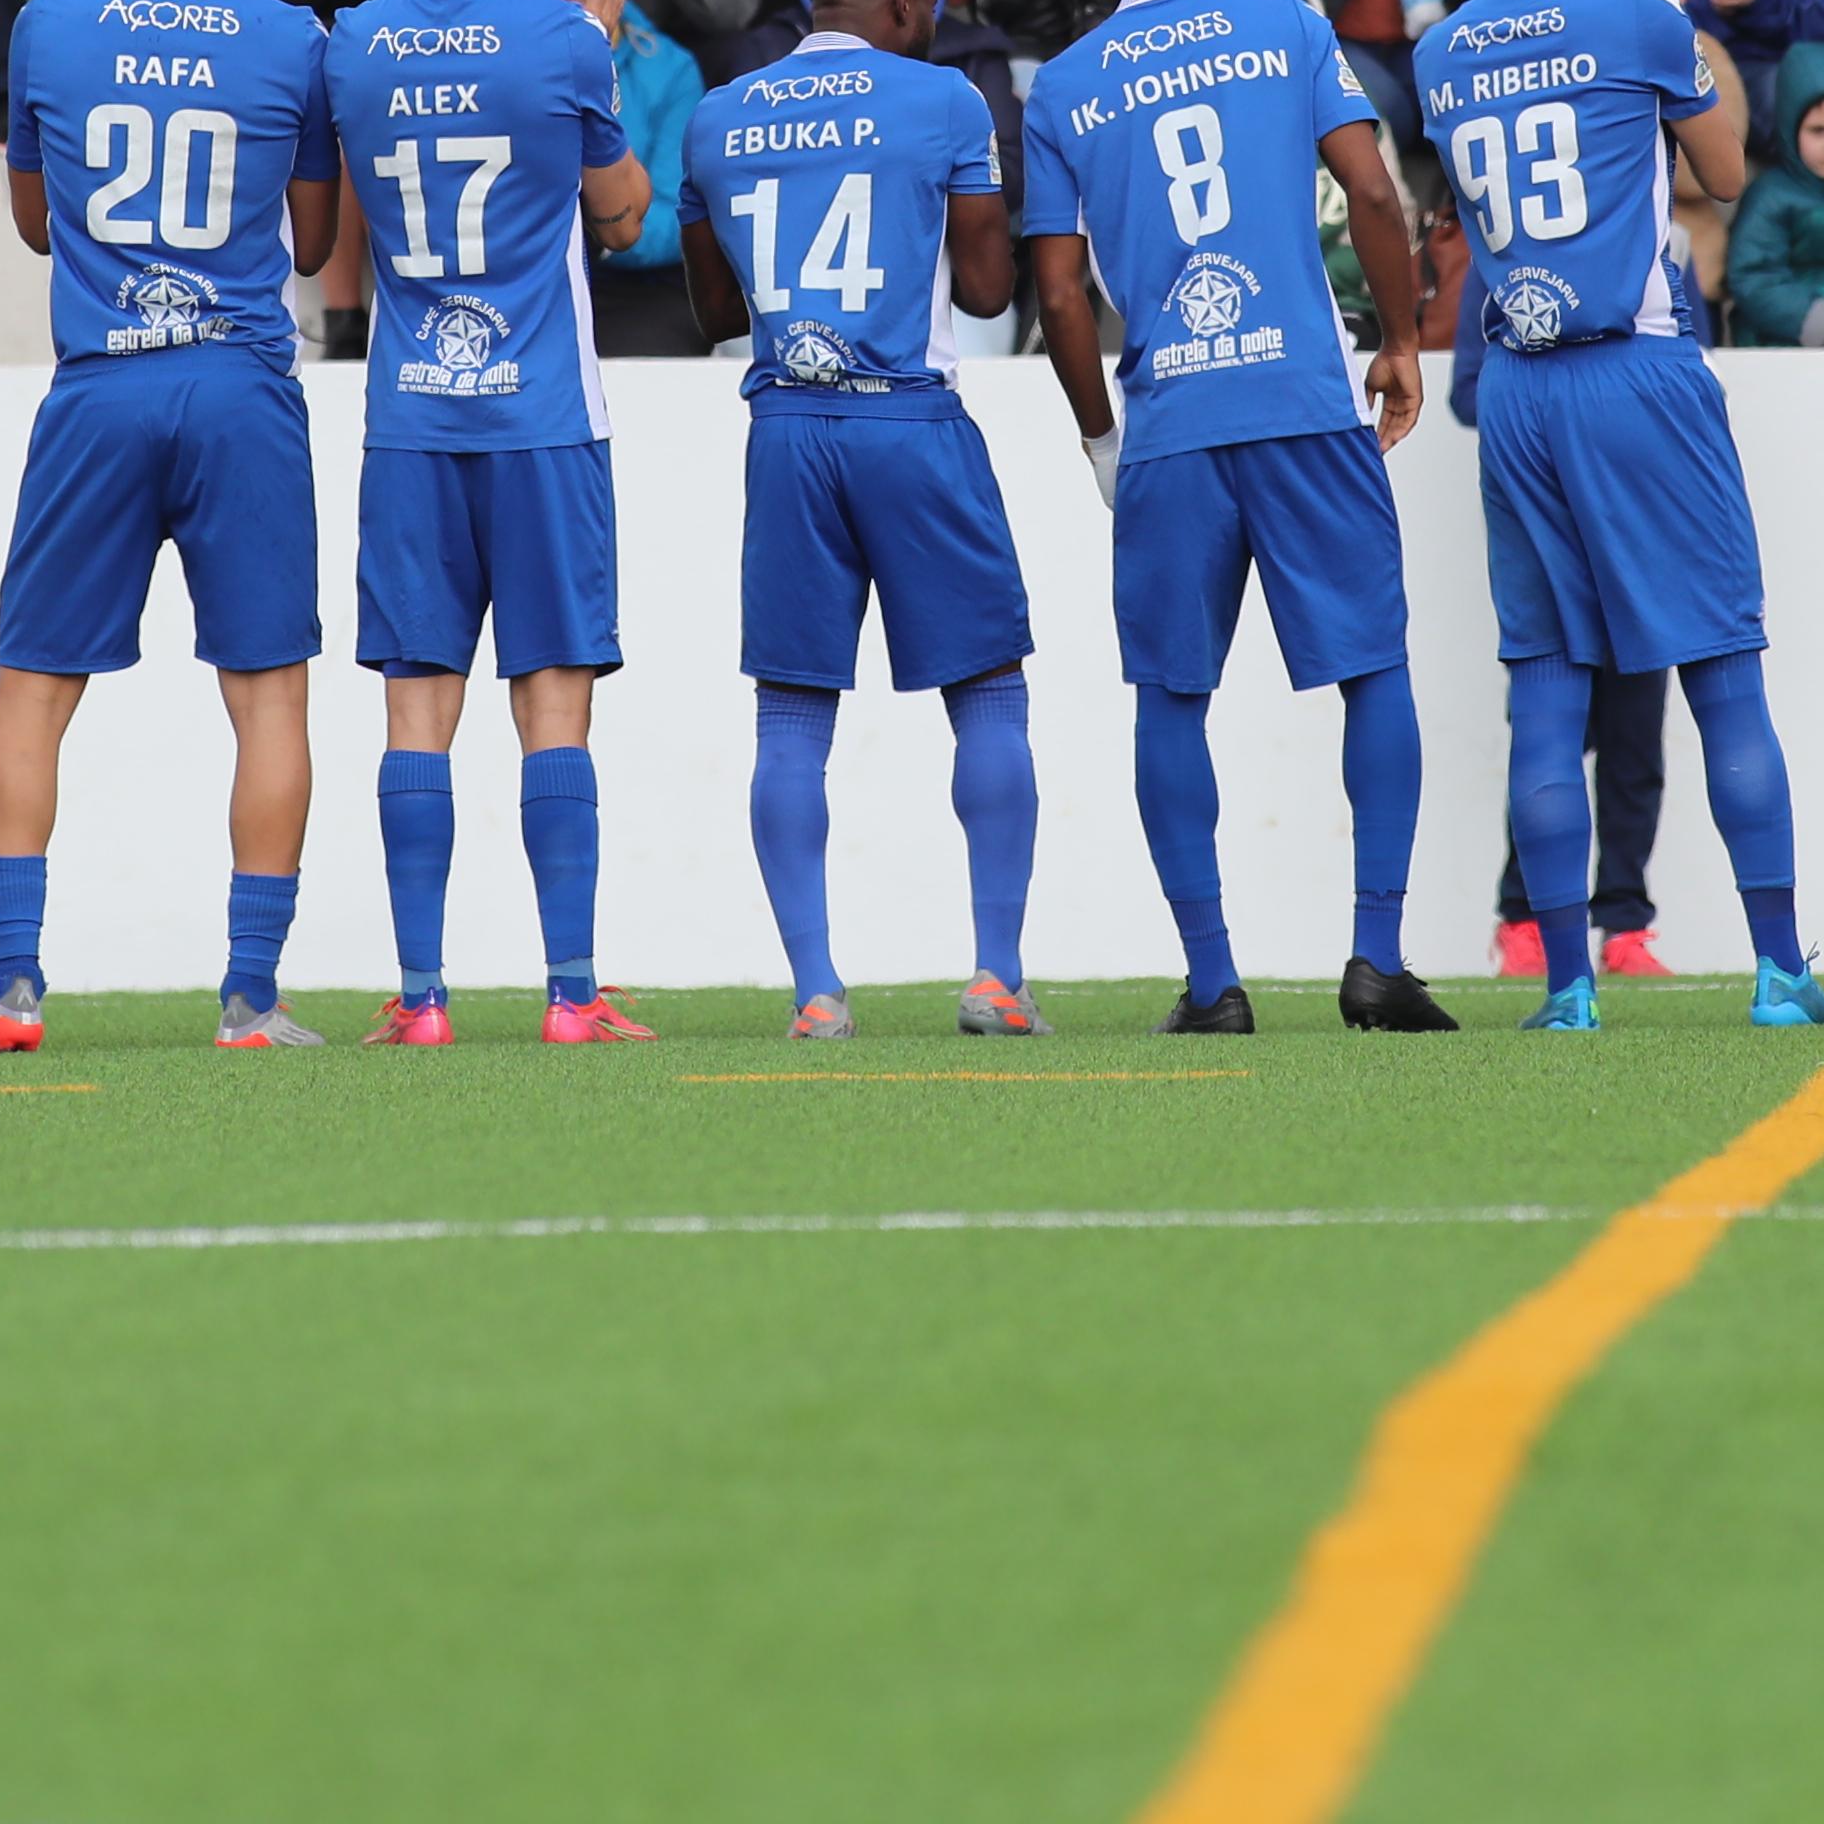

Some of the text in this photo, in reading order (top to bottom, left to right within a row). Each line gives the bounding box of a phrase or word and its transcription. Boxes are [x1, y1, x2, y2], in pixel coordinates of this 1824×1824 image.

[367, 25, 501, 62] AÇORES
[1101, 10, 1233, 69] AÇORES
[1447, 7, 1565, 54] AÇORES
[115, 54, 216, 88] RAFA
[742, 70, 873, 107] AÇORES
[1070, 49, 1289, 136] IK. JOHNSON
[1428, 53, 1597, 117] M. RIBEIRO
[388, 84, 479, 118] ALEX
[725, 118, 881, 157] EBUKA P.
[85, 103, 238, 250] 20
[1152, 103, 1232, 248] 8
[1450, 101, 1588, 255] 93
[373, 135, 512, 278] 17
[730, 173, 885, 314] 14
[1186, 252, 1262, 297] CERVEJARIA
[1508, 266, 1581, 311] CERVEJARIA
[106, 326, 167, 351] estrela
[172, 323, 193, 345] da
[416, 294, 512, 341] CAFÉ CERVEJARIA
[787, 320, 857, 368] CERVEJARIA
[1153, 326, 1284, 370] estrela da noite
[398, 360, 453, 386] estrela
[455, 371, 478, 389] da
